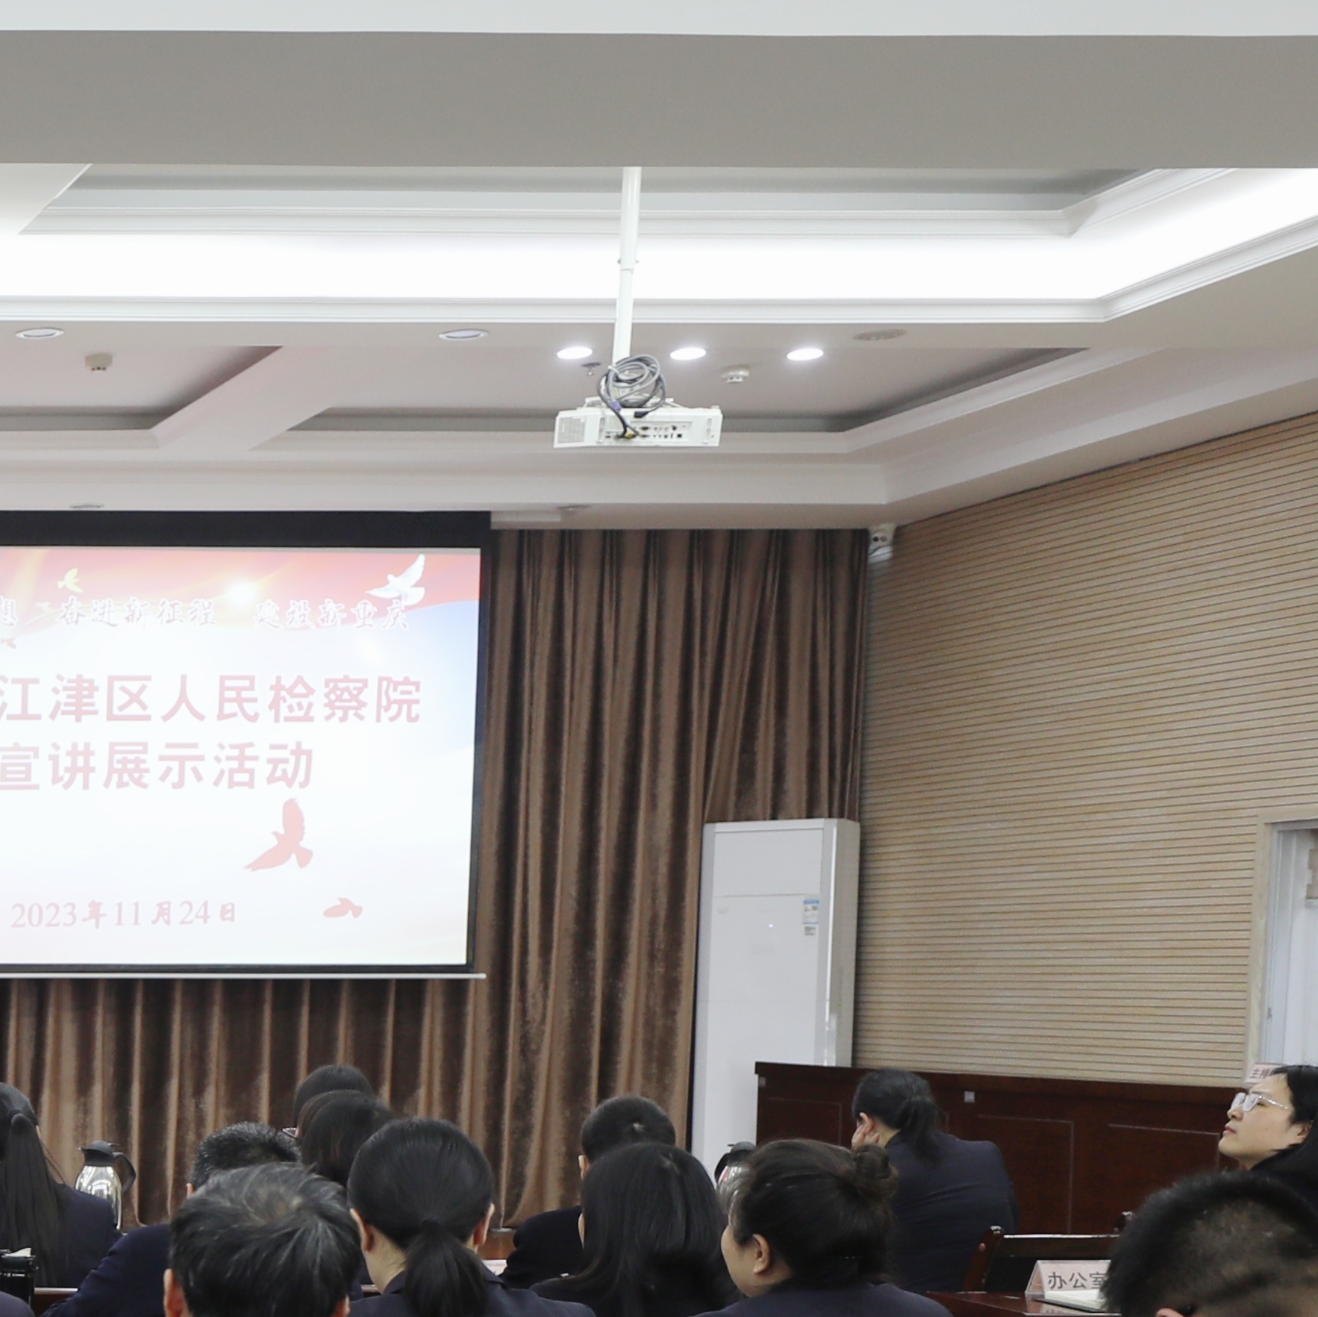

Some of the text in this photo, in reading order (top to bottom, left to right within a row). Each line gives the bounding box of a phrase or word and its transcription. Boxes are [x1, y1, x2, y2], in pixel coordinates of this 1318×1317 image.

[10, 900, 238, 930] 2023年11月24日
[1047, 1271, 1107, 1290] 办公室
